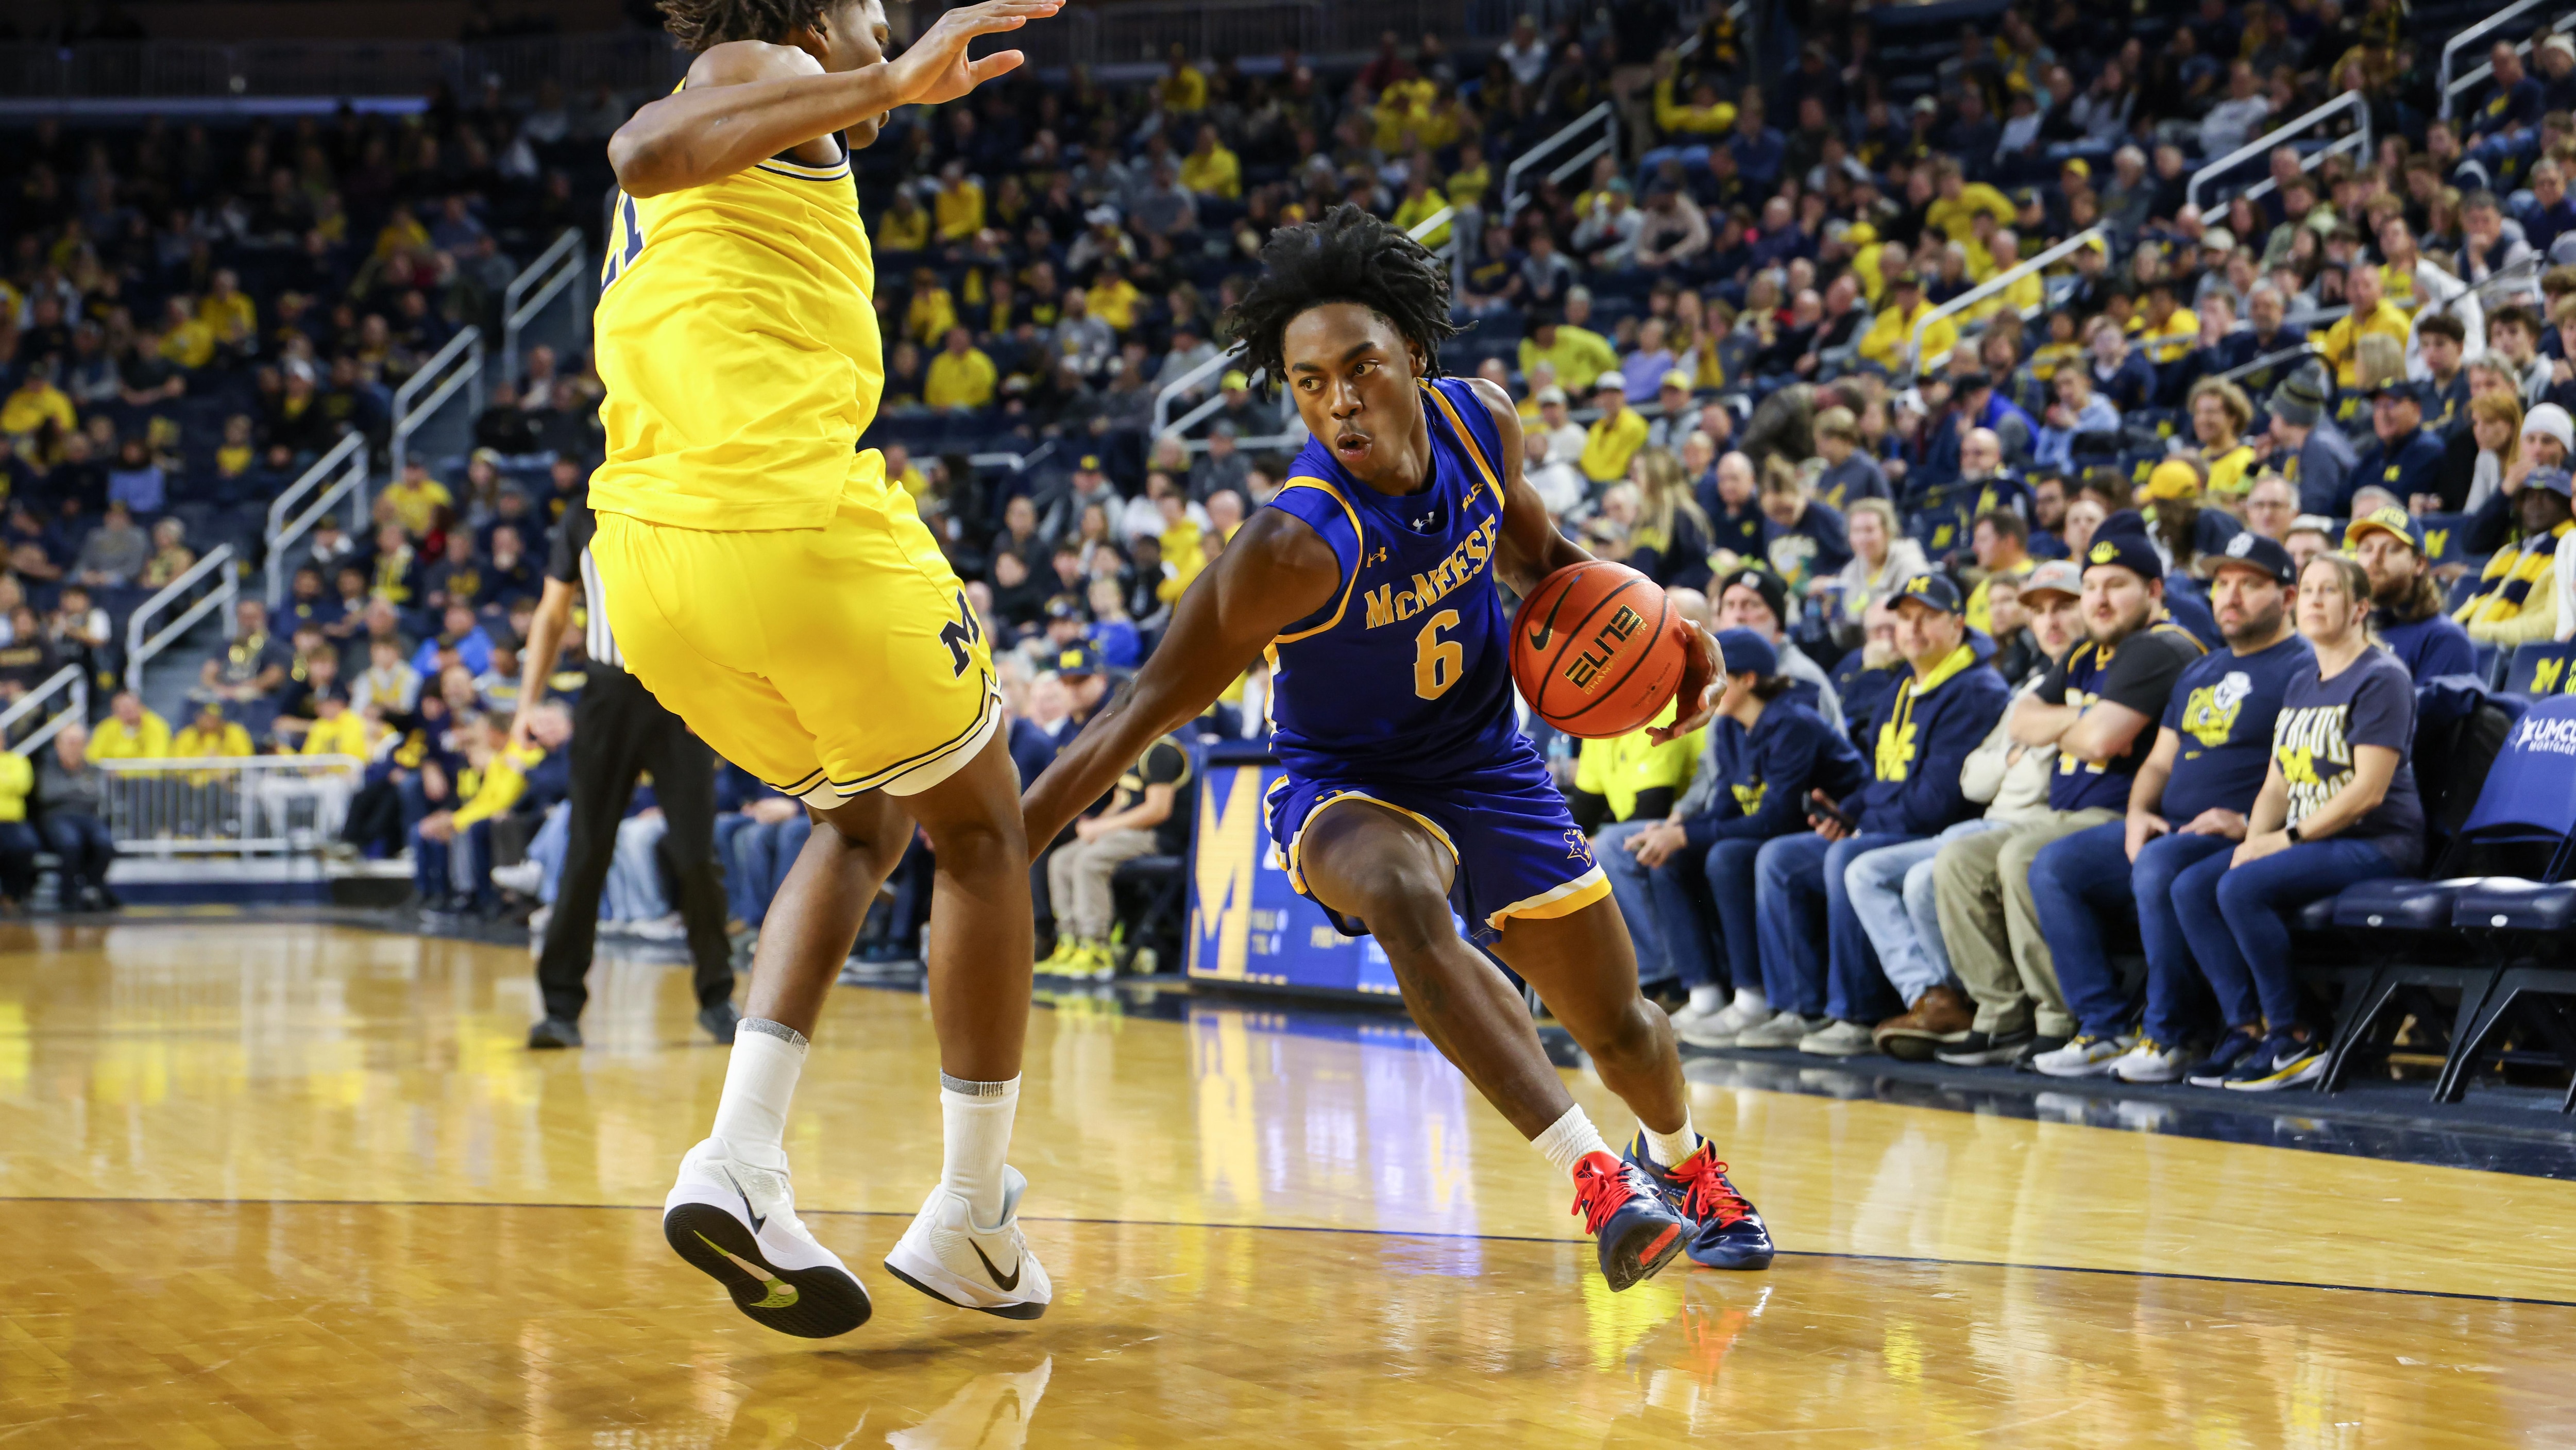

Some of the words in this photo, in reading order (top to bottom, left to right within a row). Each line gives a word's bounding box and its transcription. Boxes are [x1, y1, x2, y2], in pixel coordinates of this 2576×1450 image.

[601, 190, 646, 294] 1
[938, 586, 979, 678] M
[1413, 609, 1464, 701] 6
[1563, 604, 1643, 689] ELITE
[2528, 739, 2576, 756] MORTGAGE
